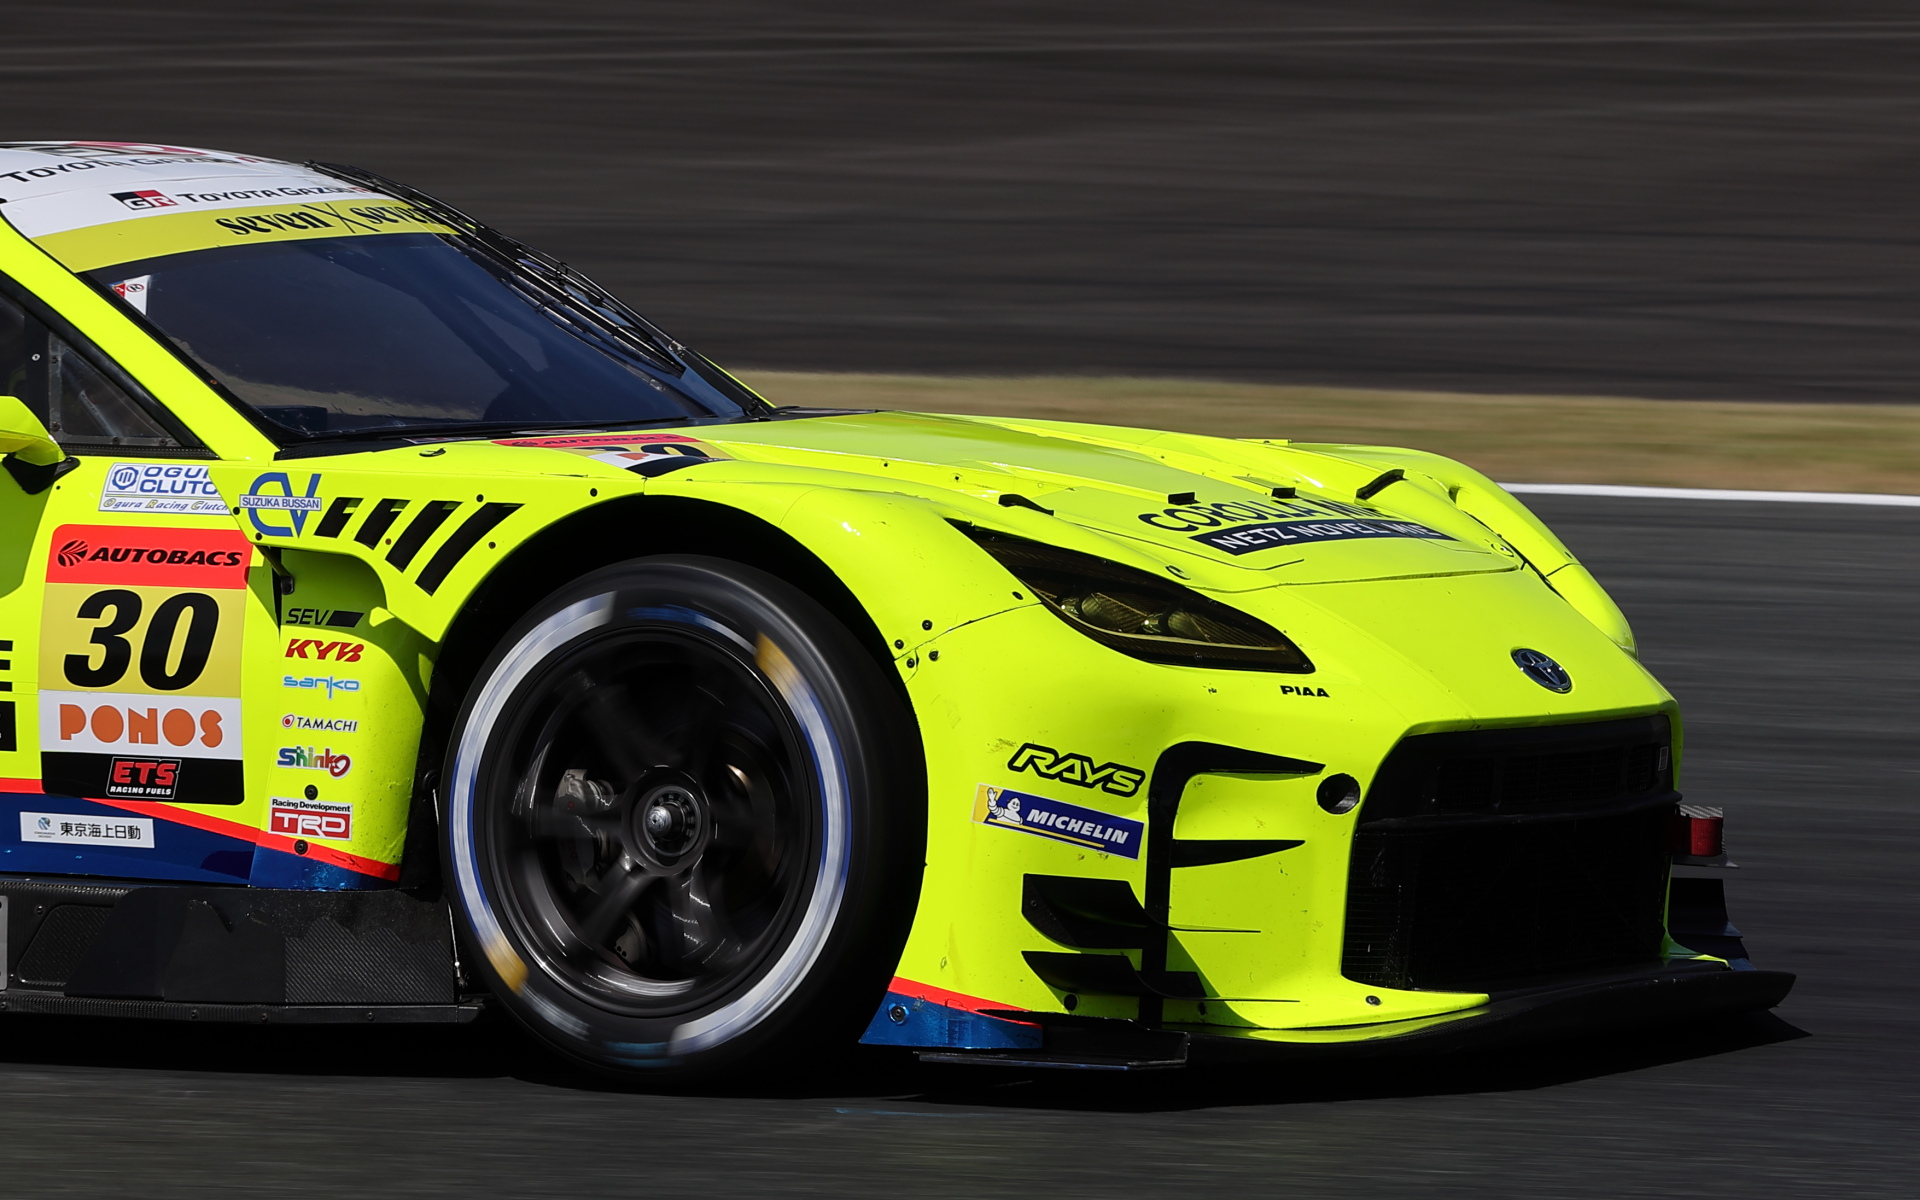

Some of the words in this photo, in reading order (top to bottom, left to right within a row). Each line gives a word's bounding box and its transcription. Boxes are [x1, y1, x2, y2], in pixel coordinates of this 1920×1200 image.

[0, 159, 136, 182] TOYOTA
[176, 190, 276, 203] TOYOTA
[278, 187, 356, 196] GAZ
[215, 211, 335, 235] seven
[350, 207, 438, 224] seve
[144, 467, 209, 479] OGU
[139, 479, 218, 495] CLUTC
[104, 498, 142, 509] Ogura
[146, 499, 187, 511] Racing
[191, 501, 228, 511] Clutch
[242, 497, 279, 508] SUZUKA
[282, 499, 319, 509] BUSSAN
[1138, 500, 1333, 532] COROLLA
[1211, 527, 1297, 549] NETZ
[1287, 523, 1391, 537] NOVEL
[90, 547, 243, 567] AUTOBACS
[286, 608, 329, 625] SEV
[64, 589, 220, 691] 30
[285, 639, 365, 662] KYB
[283, 676, 361, 699] sanko
[1280, 685, 1331, 698] PIAA
[59, 704, 223, 748] PONOS
[297, 717, 357, 732] TAMACHI
[113, 761, 176, 785] ETS
[277, 746, 351, 777] Shinko
[1008, 743, 1146, 798] RAYS
[146, 787, 172, 795] FUELS
[272, 799, 298, 809] Racing
[299, 801, 350, 812] Development
[60, 822, 141, 840] 東京海上日動
[275, 812, 346, 837] TRD
[1026, 809, 1129, 844] MICHELIN
